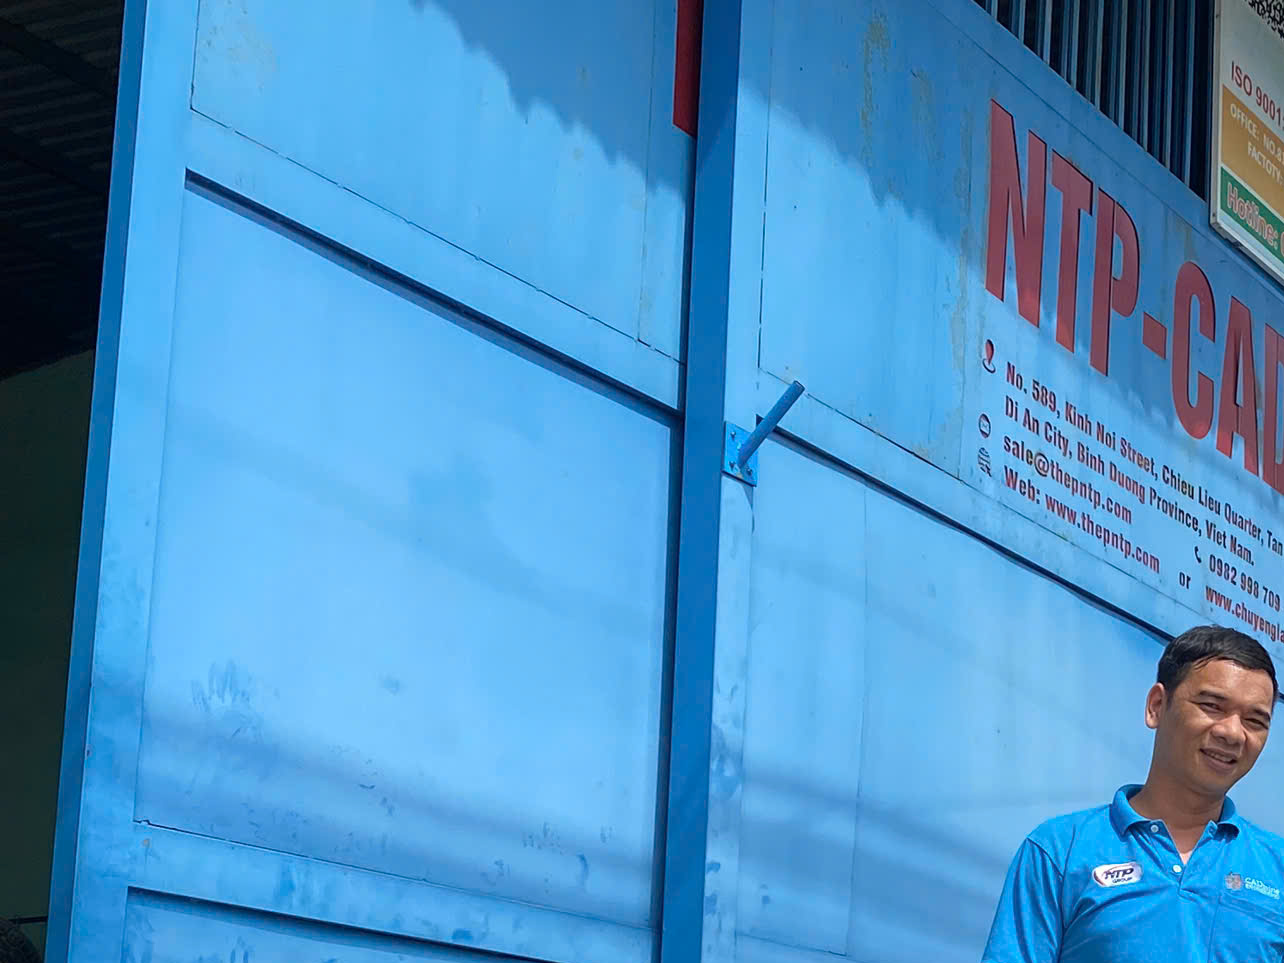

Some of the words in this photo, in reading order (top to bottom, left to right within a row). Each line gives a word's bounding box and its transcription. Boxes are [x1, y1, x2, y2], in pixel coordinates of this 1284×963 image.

[1231, 60, 1252, 96] ISO
[1230, 100, 1259, 142] OFFICE:
[1227, 182, 1278, 250] Hotline:
[1003, 430, 1131, 530] sale@thepntp.com
[1005, 394, 1018, 422] Di
[1022, 405, 1039, 436] An
[1044, 419, 1072, 460] City,
[1077, 441, 1104, 476] Binh
[1109, 460, 1144, 505] Duong
[1149, 485, 1201, 537] Province,
[1205, 518, 1226, 549] Viet
[1230, 533, 1253, 566] Nam.
[1006, 360, 1027, 395] No.
[1032, 377, 1060, 419] 589,
[1065, 400, 1091, 437] Kinh
[1096, 420, 1116, 452] Noi
[1120, 435, 1157, 481] Street,
[1162, 462, 1194, 501] Chieu
[1198, 485, 1220, 517] Lieu
[1224, 501, 1263, 546] Quarter,
[1266, 529, 1282, 556] Tan
[1004, 464, 1039, 505] Web:
[1044, 490, 1159, 577] www.thepntp.com
[1179, 570, 1190, 591] or
[1209, 552, 1236, 587] 0982
[1240, 571, 1258, 600] 998
[1262, 585, 1280, 613] 709
[1104, 867, 1134, 880] NTP
